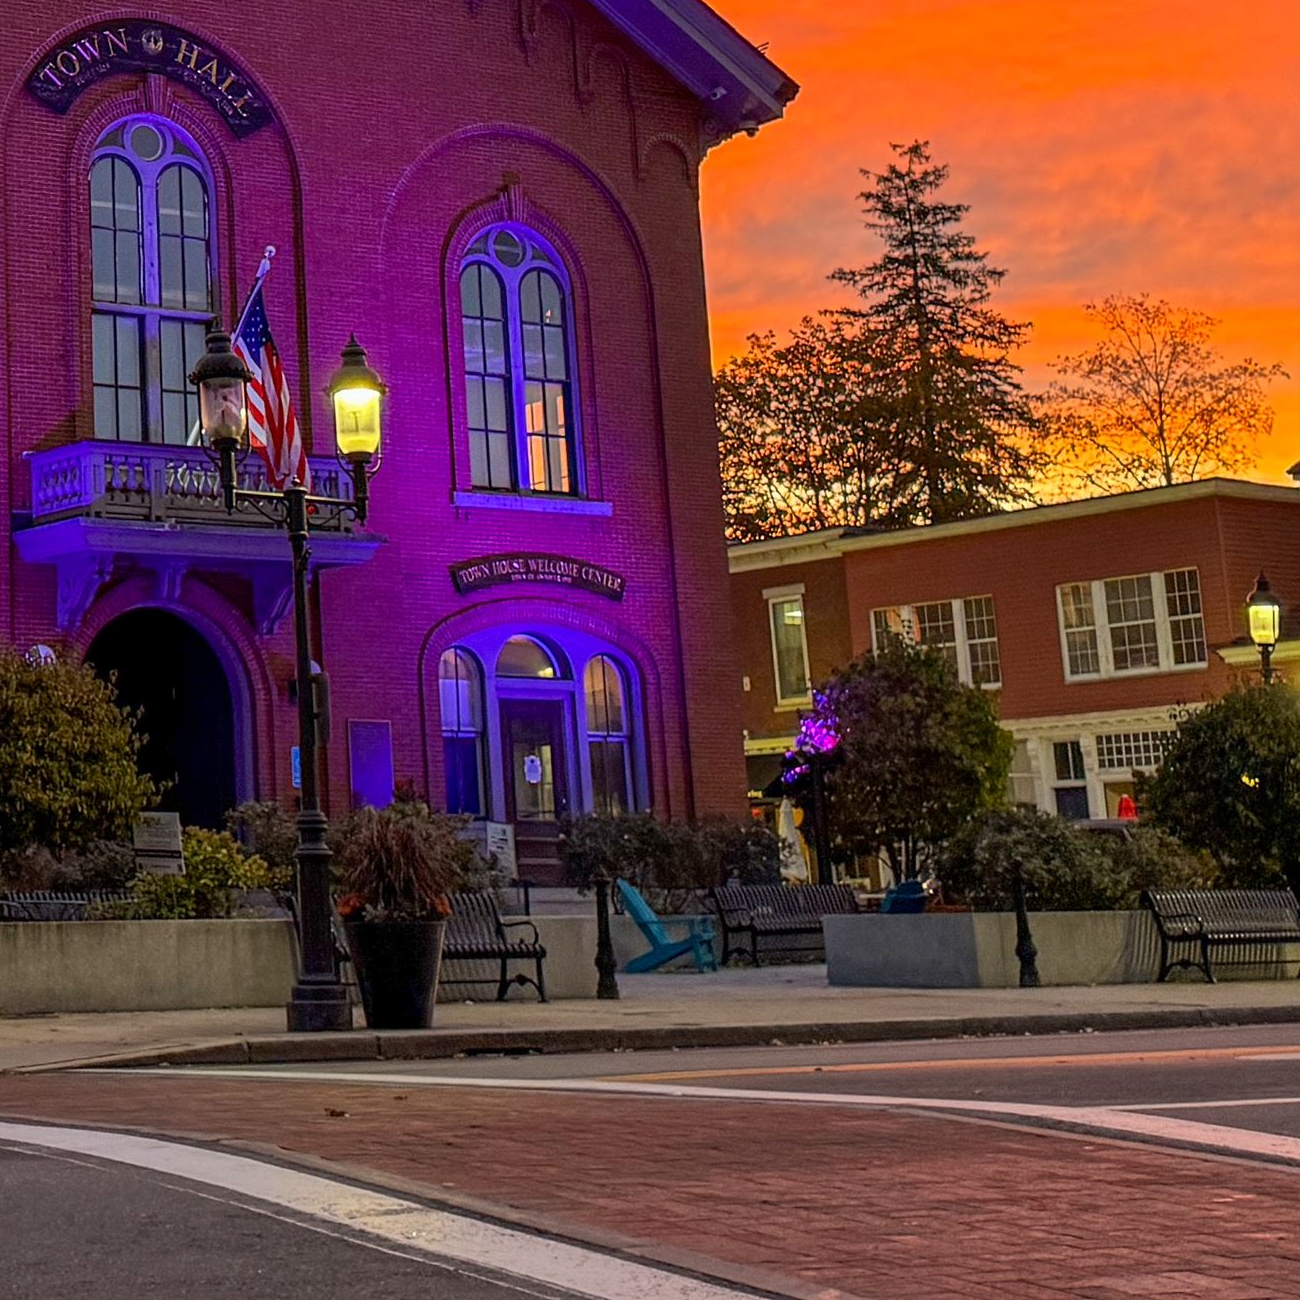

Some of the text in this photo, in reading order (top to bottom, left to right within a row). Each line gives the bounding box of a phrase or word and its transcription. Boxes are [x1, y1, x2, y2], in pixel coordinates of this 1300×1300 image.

[39, 28, 130, 90] TOWN
[174, 38, 254, 117] HALL
[459, 565, 491, 584] TOWN
[492, 559, 526, 576] HOUSE
[527, 559, 579, 577] WELCOME
[581, 566, 621, 592] CENTER
